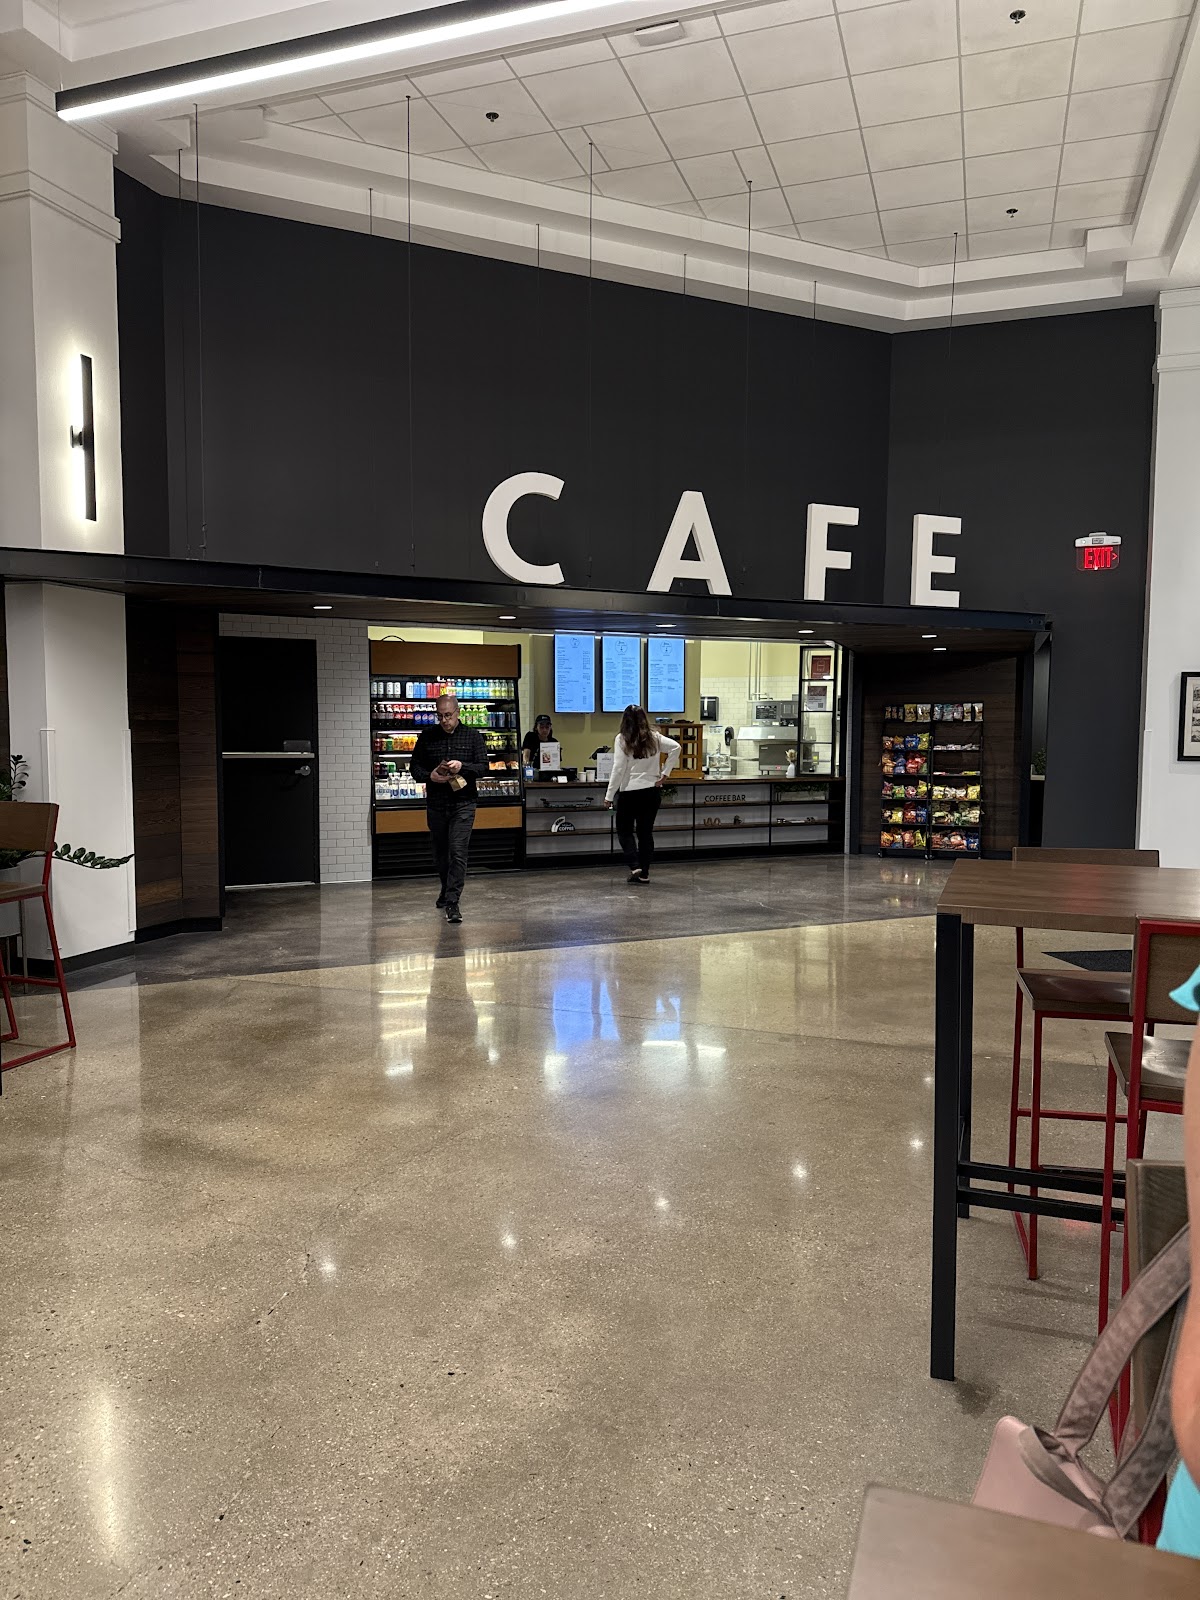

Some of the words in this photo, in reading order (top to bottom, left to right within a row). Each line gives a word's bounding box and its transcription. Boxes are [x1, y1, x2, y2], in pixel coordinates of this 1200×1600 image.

[482, 471, 962, 608] CAFE
[1084, 546, 1113, 568] EXIT
[704, 794, 732, 802] COFFEE
[732, 794, 746, 802] BAR
